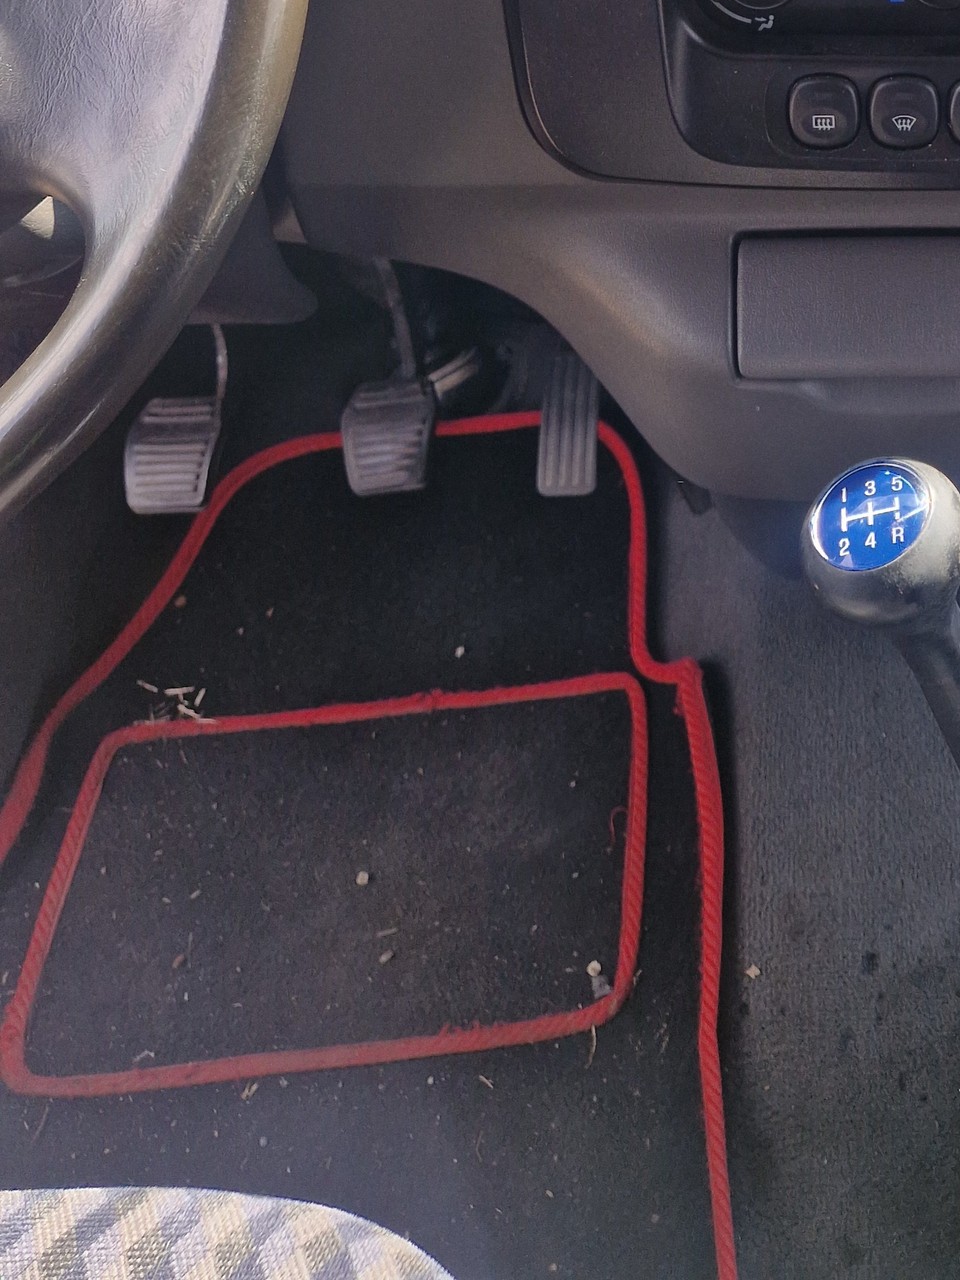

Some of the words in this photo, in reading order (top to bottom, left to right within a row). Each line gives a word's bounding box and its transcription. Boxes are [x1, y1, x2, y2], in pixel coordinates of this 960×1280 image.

[841, 487, 847, 503] 1
[864, 480, 876, 496] 3
[891, 476, 903, 491] 5
[839, 538, 850, 557] 2
[864, 532, 877, 549] 4
[892, 527, 904, 544] R
